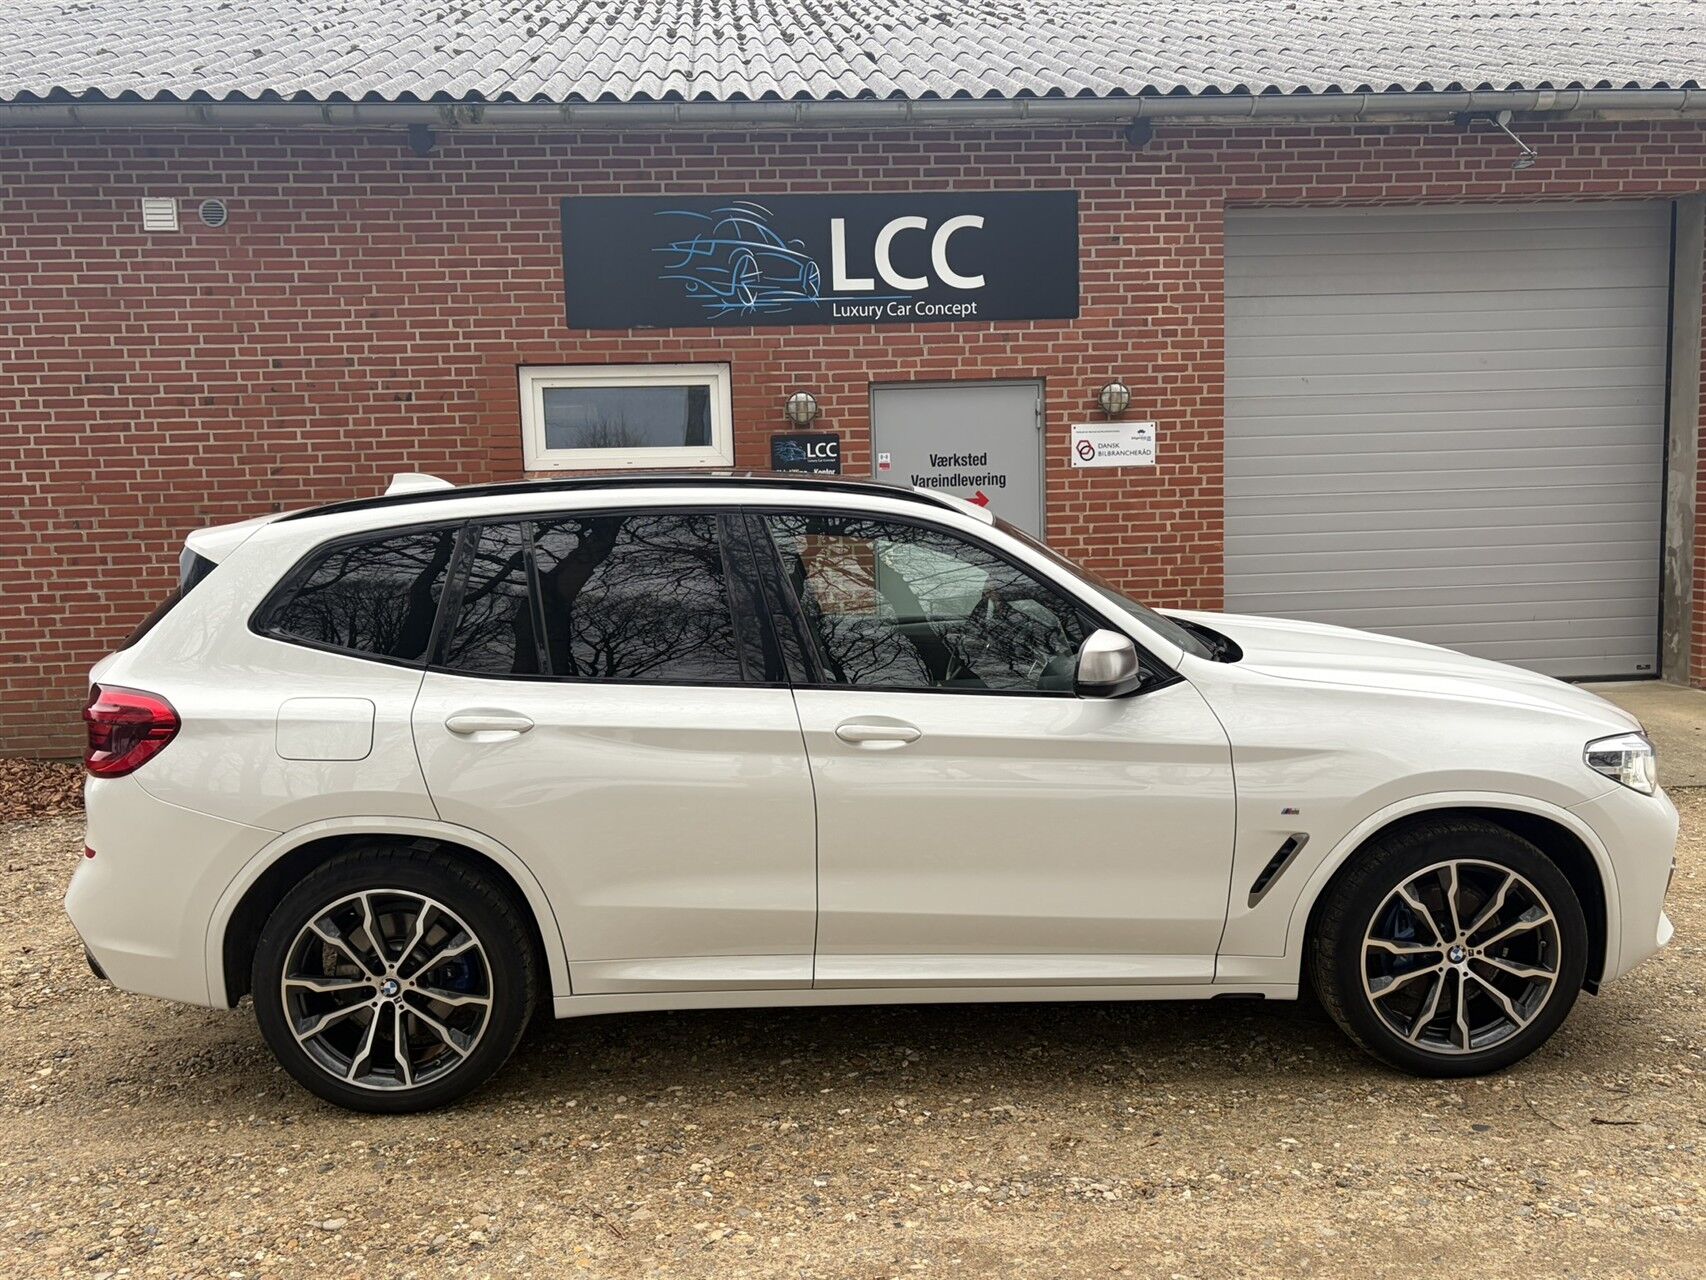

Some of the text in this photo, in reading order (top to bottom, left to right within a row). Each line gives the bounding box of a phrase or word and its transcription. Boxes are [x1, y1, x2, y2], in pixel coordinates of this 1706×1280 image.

[831, 214, 985, 291] LCC
[833, 301, 977, 319] Luxury Car Concept
[807, 442, 837, 458] LCC
[930, 452, 987, 467] Værksted
[911, 472, 1006, 488] Vareindlevering
